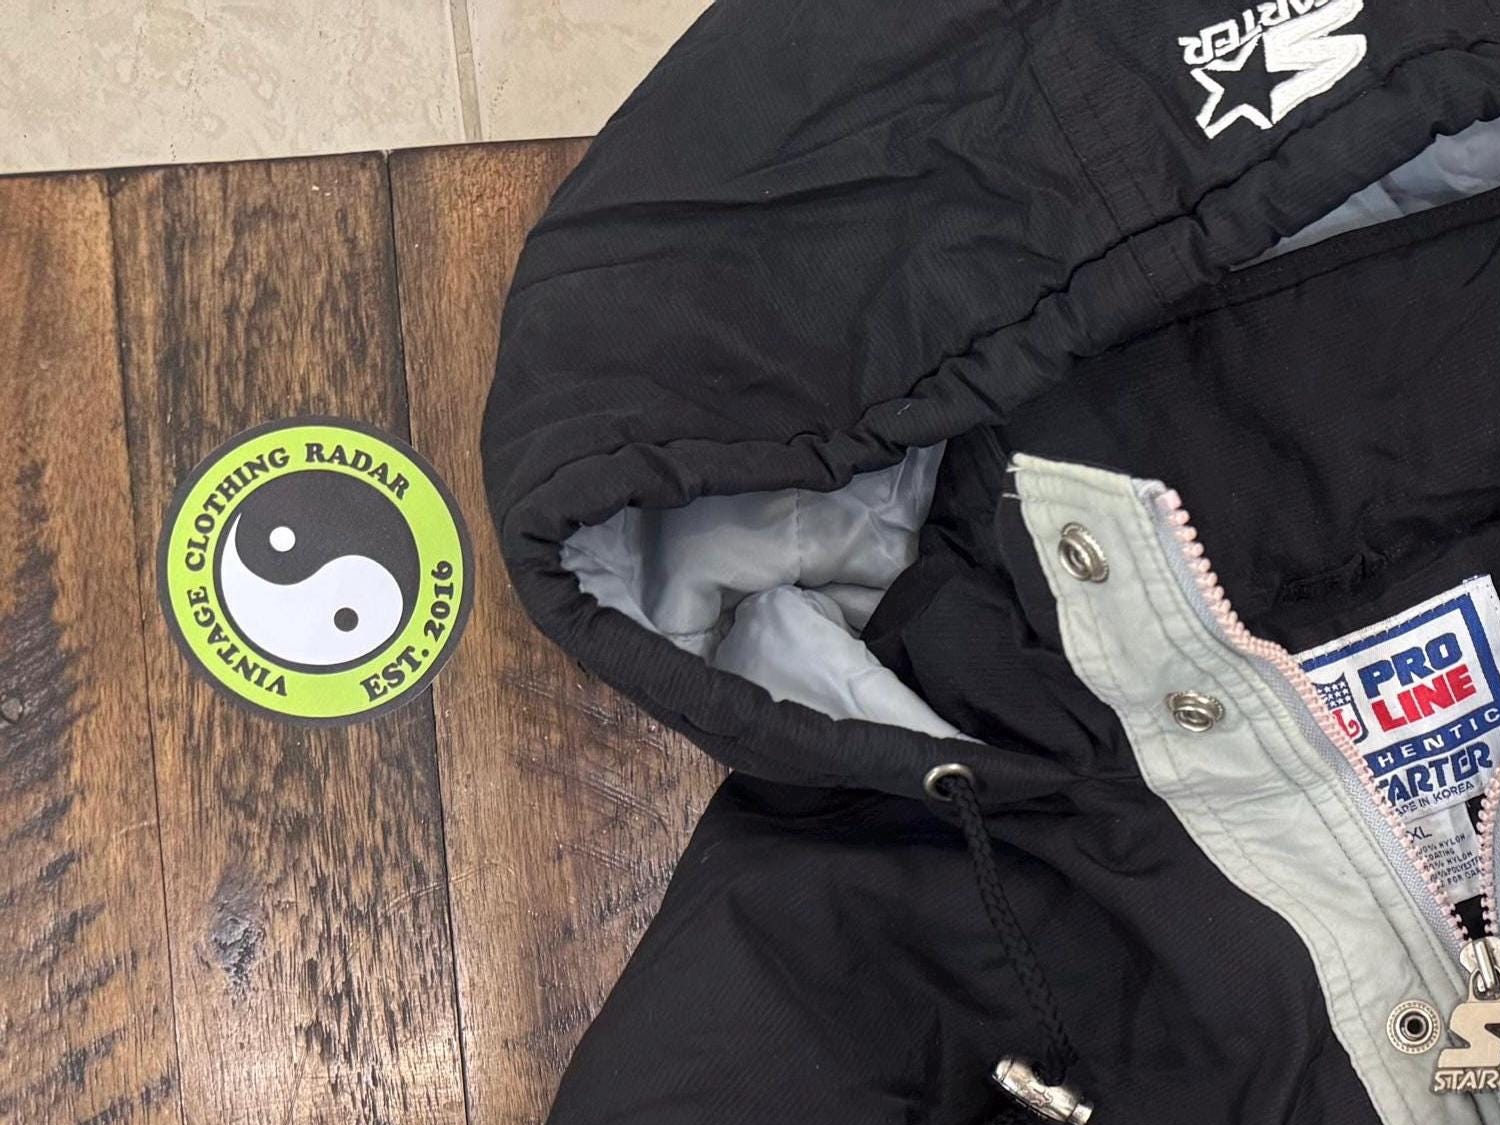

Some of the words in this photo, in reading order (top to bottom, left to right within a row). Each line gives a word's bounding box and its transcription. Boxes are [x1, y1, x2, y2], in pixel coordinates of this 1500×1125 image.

[304, 441, 412, 502] RADAR
[184, 447, 291, 573] CLOTHING
[186, 585, 289, 698] VINTAGE
[360, 644, 431, 703] EST.
[423, 559, 454, 643] 2016
[1356, 632, 1463, 700] PRO
[1370, 663, 1478, 733] LINE
[1376, 741, 1494, 809] ARTER
[1394, 800, 1418, 817] ADE
[1419, 796, 1431, 808] IN
[1432, 780, 1475, 803] KOREA
[1439, 832, 1466, 848] NYLON
[1446, 850, 1473, 866] NYLON
